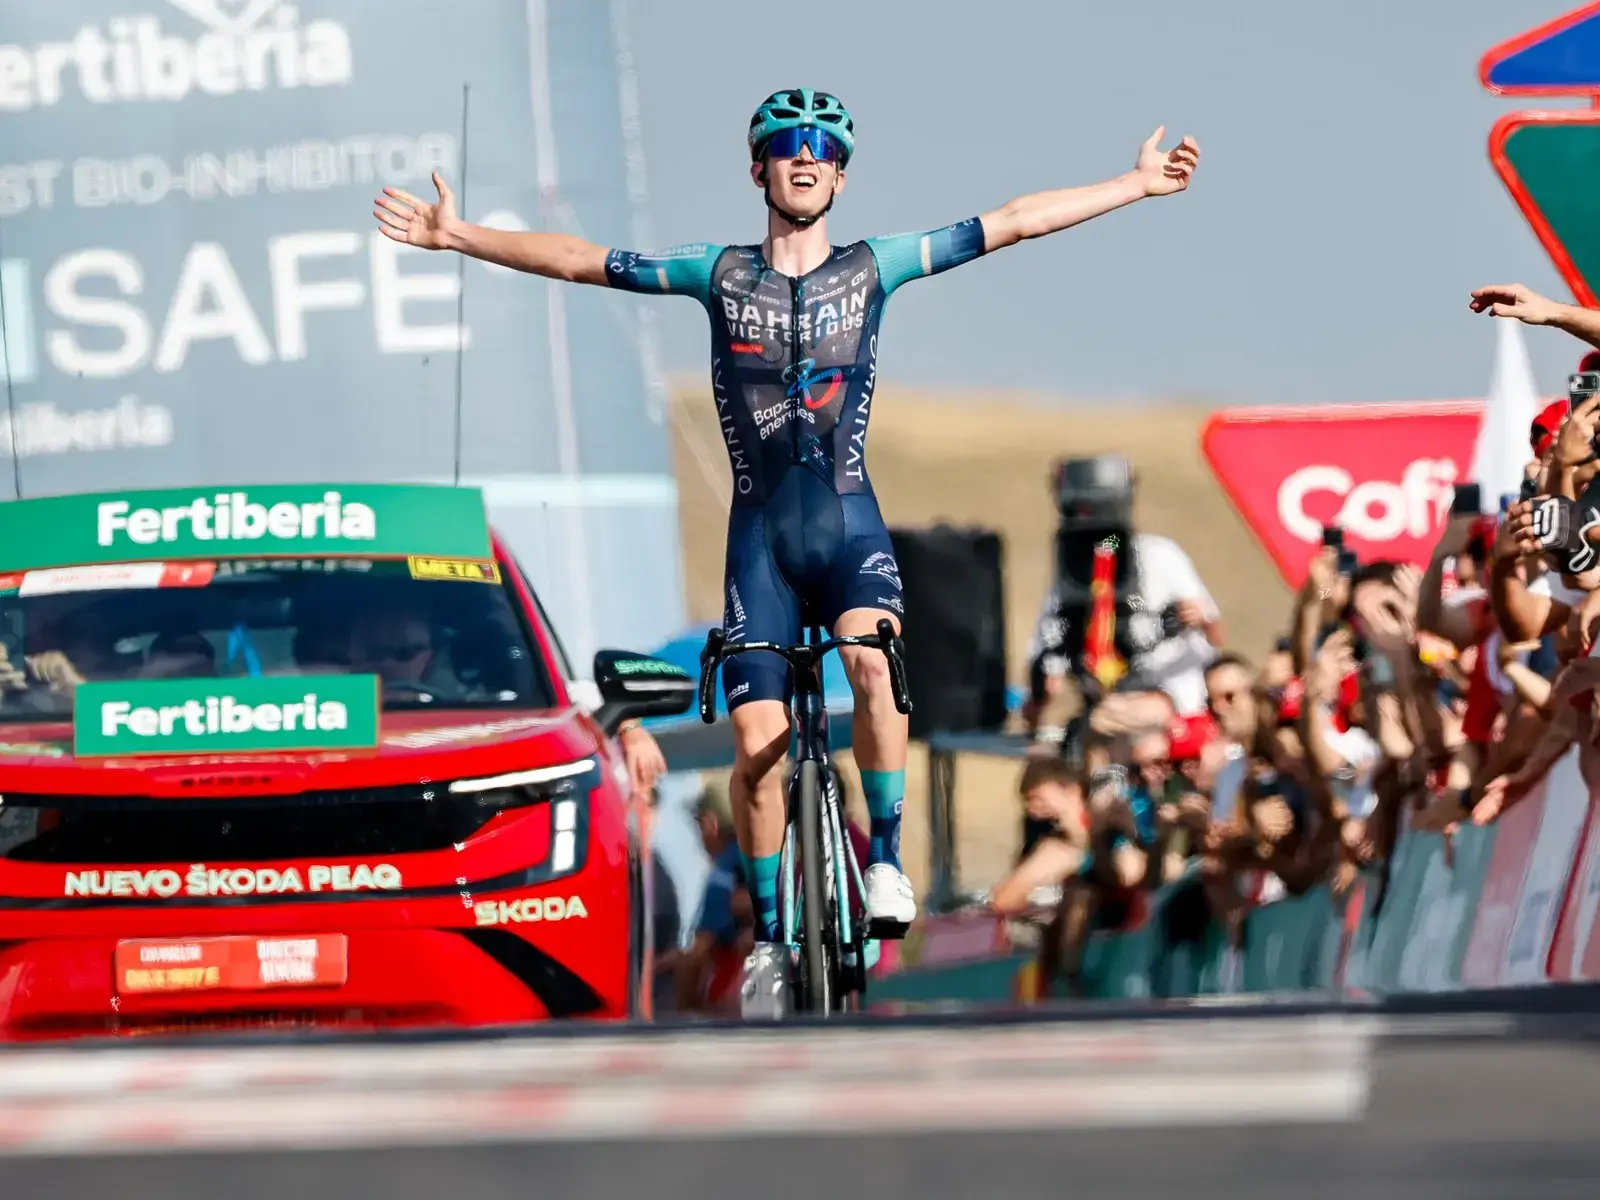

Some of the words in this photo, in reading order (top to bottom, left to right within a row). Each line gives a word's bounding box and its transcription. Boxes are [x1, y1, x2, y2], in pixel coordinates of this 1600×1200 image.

[722, 286, 867, 333] BAHRAIN
[726, 312, 864, 343] VICTORIOUS
[845, 334, 877, 482] OMNIYAT
[98, 491, 376, 546] Fertiberia
[101, 694, 348, 736] Fertiberia
[64, 869, 182, 898] NUEVO
[185, 864, 304, 896] ŠKODA
[308, 864, 403, 891] PEAQ
